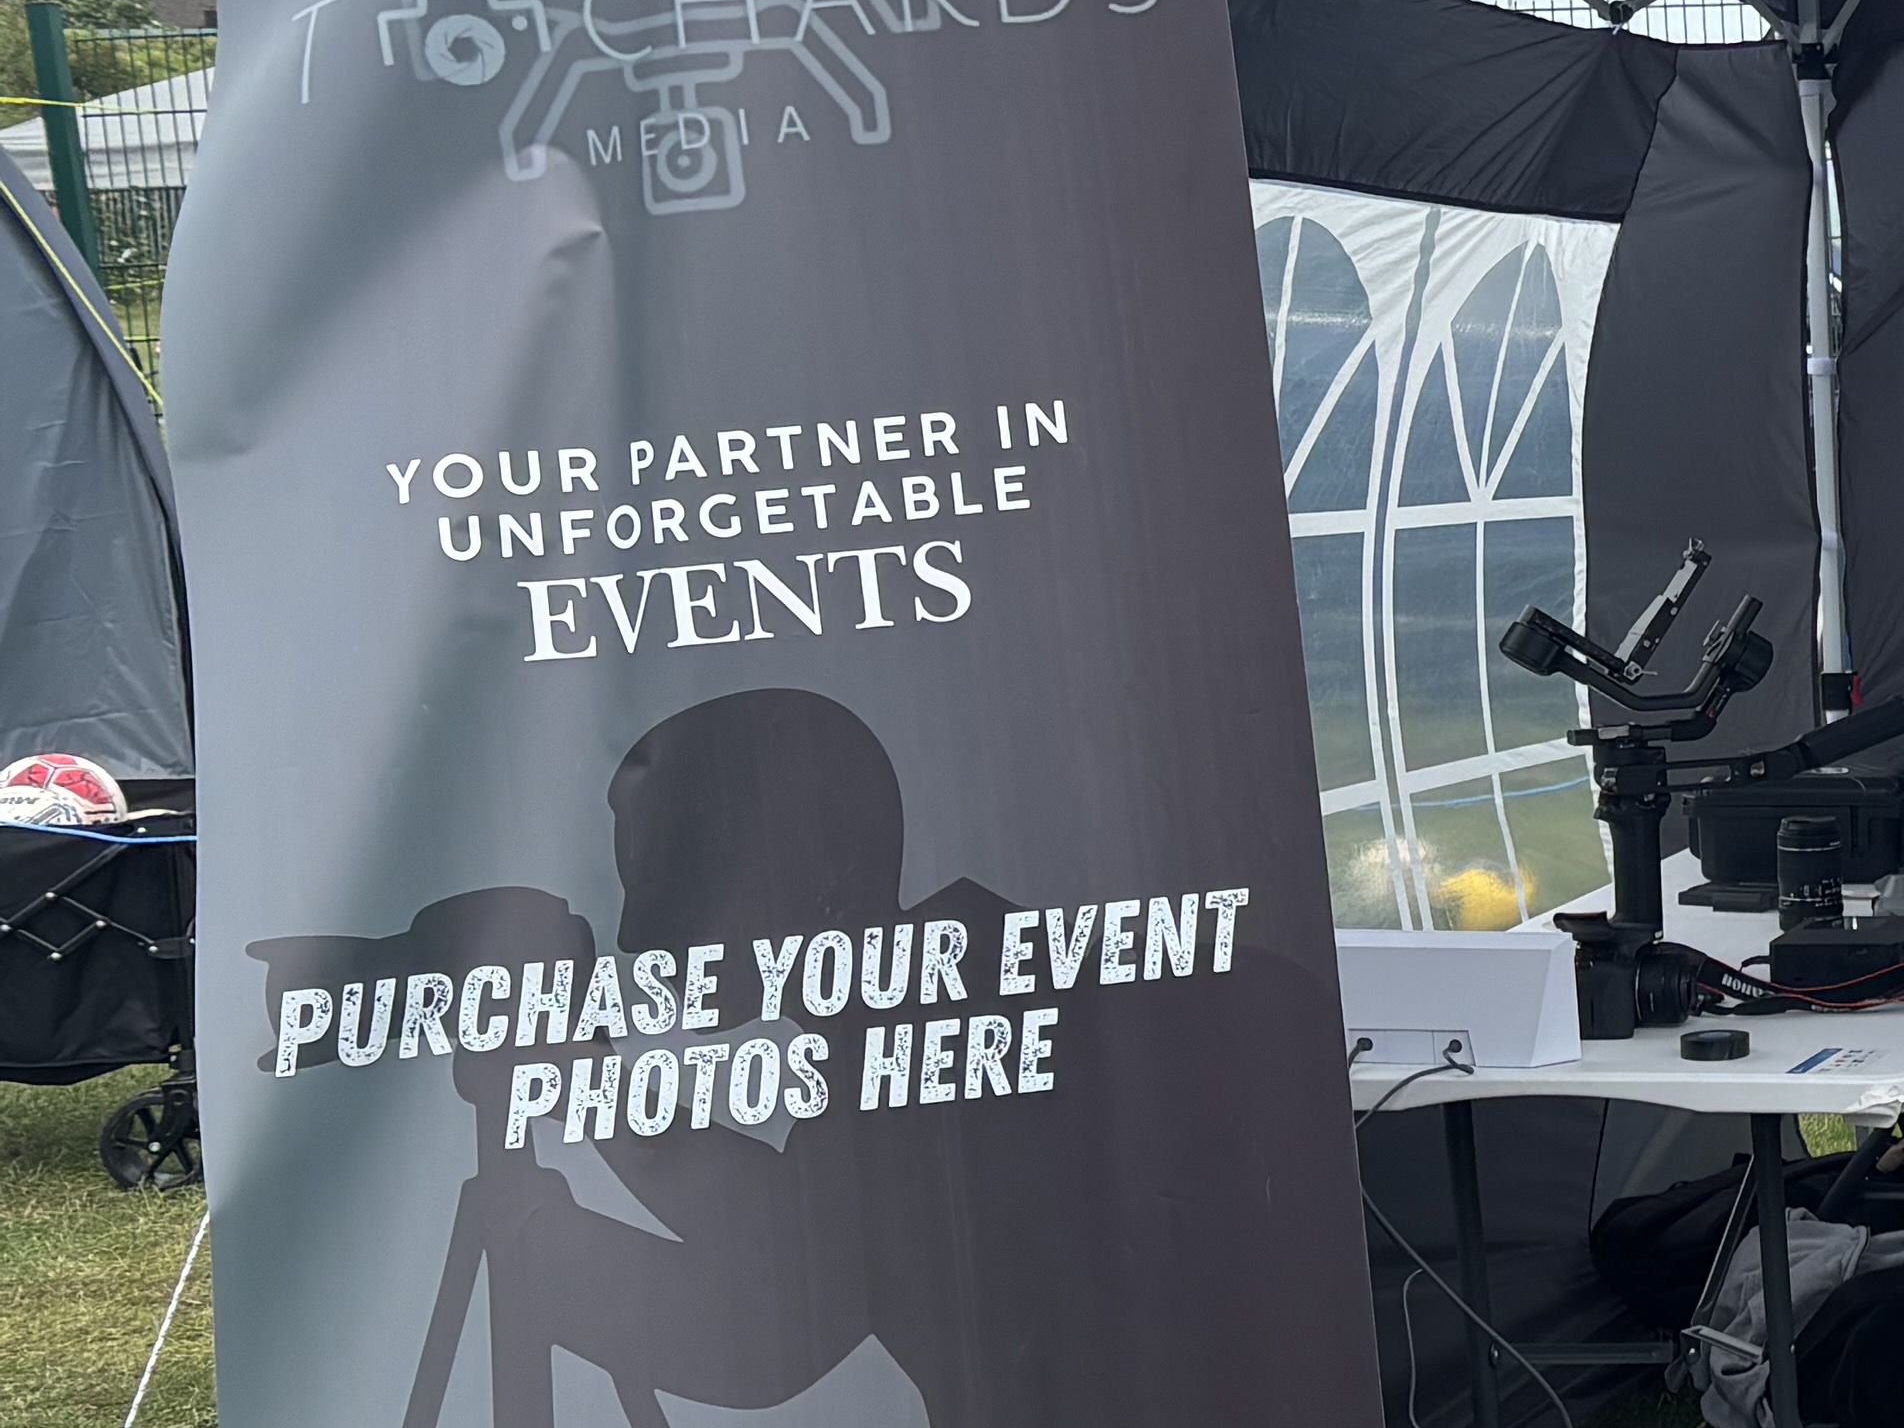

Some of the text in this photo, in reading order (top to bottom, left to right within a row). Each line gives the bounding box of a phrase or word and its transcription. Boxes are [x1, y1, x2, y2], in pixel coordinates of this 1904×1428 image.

[587, 105, 811, 165] MEDIA
[387, 400, 1069, 506] YOUR PARTNER IN
[438, 466, 1031, 562] UNFORGETABLE
[518, 538, 973, 661] EVENTS
[274, 888, 1250, 1079] PURCHASE YOUR EVENT
[504, 1009, 1058, 1149] PHOTOS HERE
